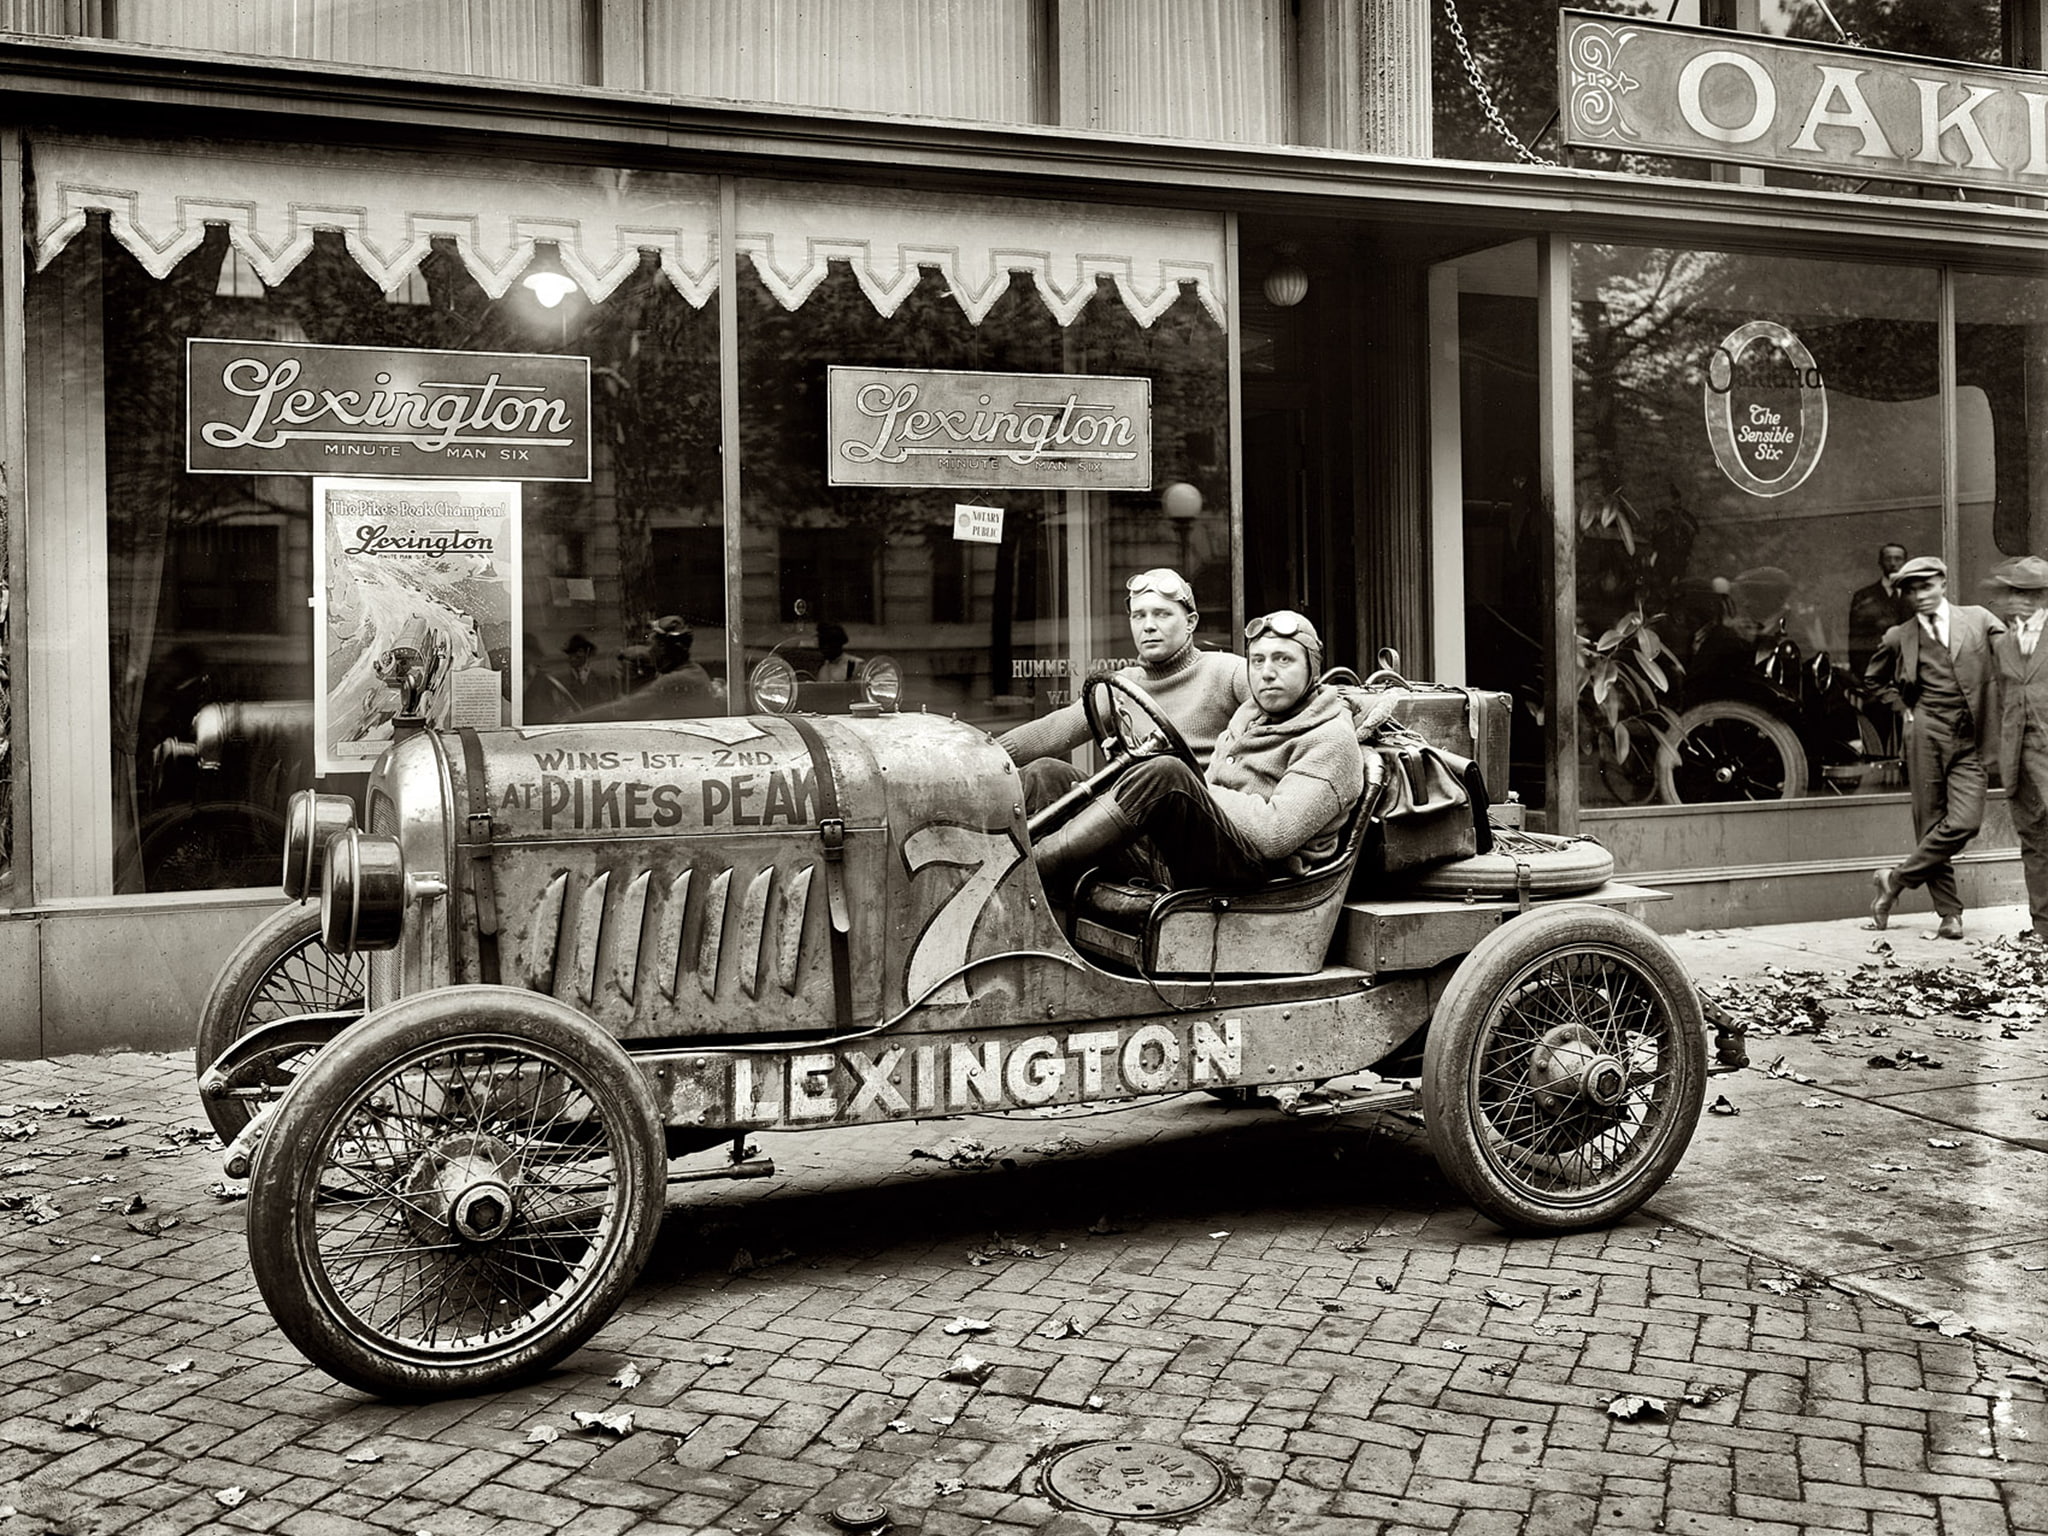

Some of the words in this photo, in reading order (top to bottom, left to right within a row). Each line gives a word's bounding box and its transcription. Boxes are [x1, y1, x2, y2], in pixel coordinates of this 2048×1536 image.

[201, 357, 574, 453] Lexington
[1749, 404, 1781, 425] The
[840, 383, 1138, 465] Lexington
[1738, 425, 1794, 443] Sensible
[324, 443, 401, 458] MINUTE
[446, 448, 487, 460] MAN
[500, 449, 530, 461] SIX
[1755, 443, 1783, 460] Six
[937, 458, 1000, 471] MINUTE
[1035, 460, 1068, 472] MAN
[1077, 460, 1102, 473] SIX
[331, 500, 357, 516] The
[359, 500, 399, 516] Pike's
[400, 501, 434, 517] Peak
[972, 511, 1000, 524] NOTARY
[972, 525, 998, 538] PUBLIC
[345, 525, 494, 558] Lexington
[1012, 659, 1079, 678] HUMMER
[501, 783, 536, 810] AT
[542, 774, 684, 830] PIKES
[702, 766, 822, 827] PEAK
[901, 820, 1028, 1006] 7
[730, 1018, 1242, 1122] LEXINGTON
